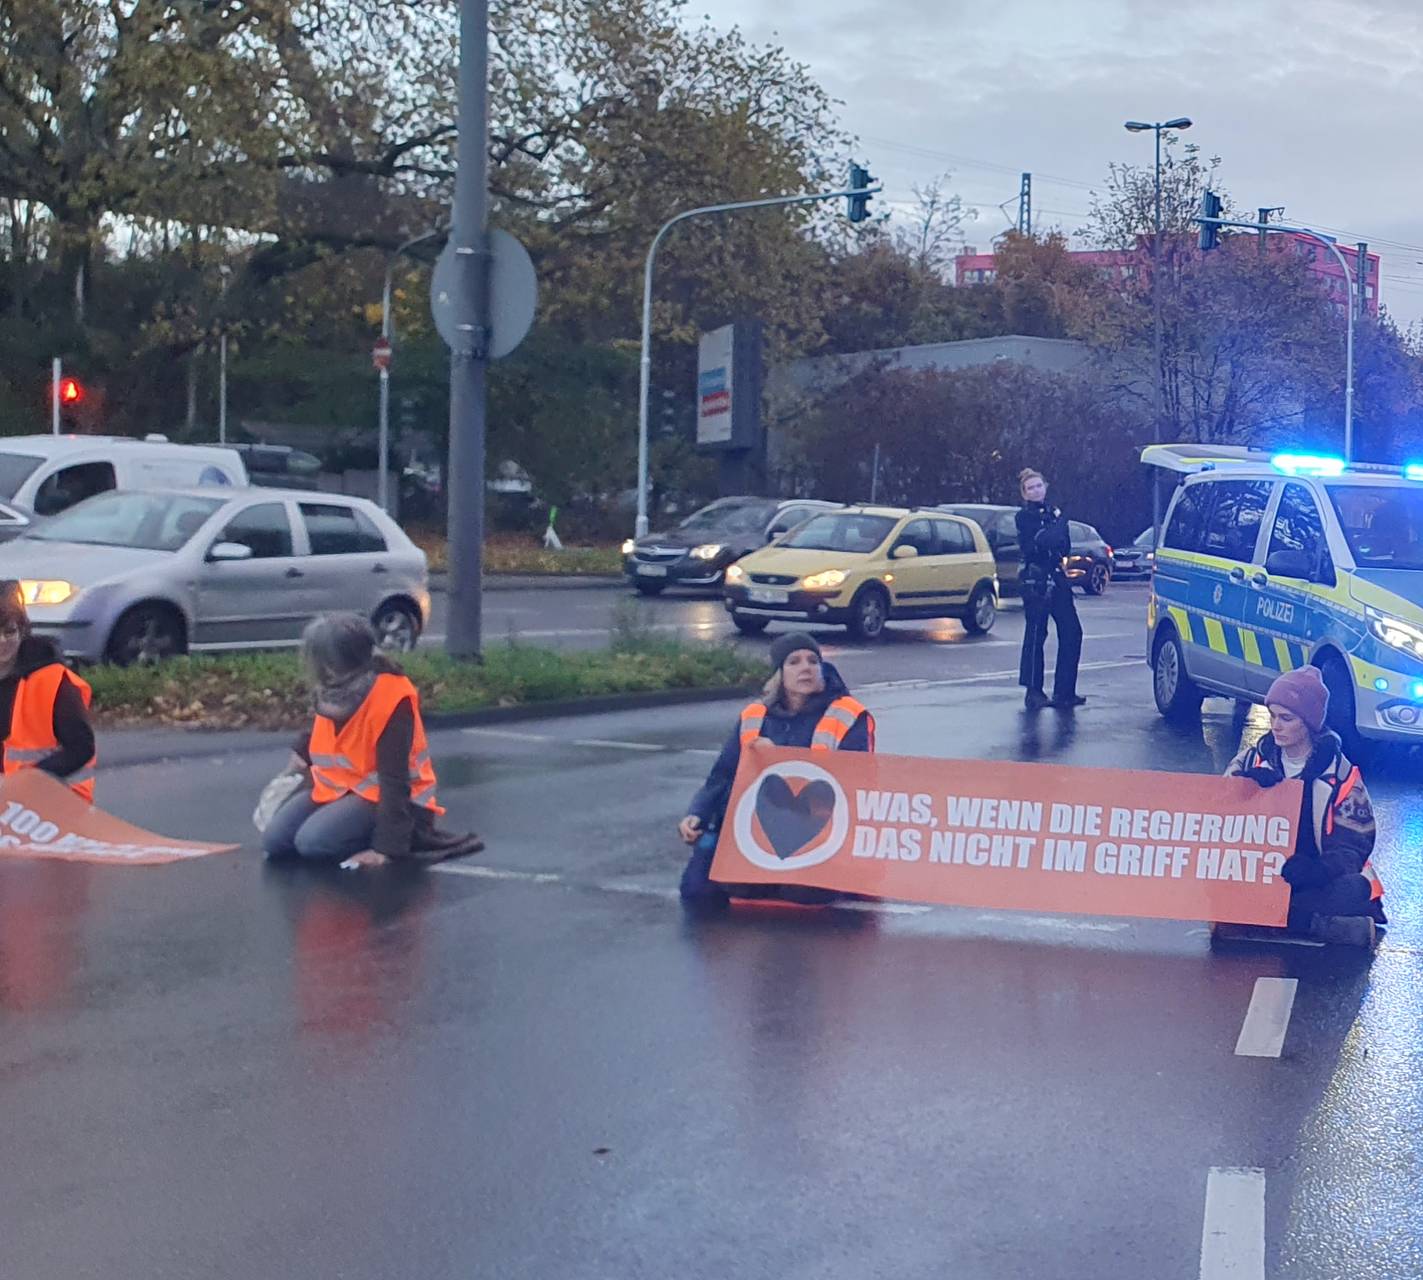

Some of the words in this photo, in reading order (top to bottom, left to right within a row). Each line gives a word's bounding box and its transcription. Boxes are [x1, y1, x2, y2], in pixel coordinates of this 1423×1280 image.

[1256, 596, 1295, 625] POLIZEI
[0, 801, 59, 843] 100
[855, 789, 938, 828] WAS,
[946, 796, 1043, 832] WENN
[1049, 803, 1103, 836] DIE
[1109, 807, 1291, 848] REGIERUNG
[852, 825, 923, 861] DAS
[928, 831, 1037, 868] NICHT
[1041, 838, 1088, 873] IM
[1094, 842, 1191, 878] GRIFF
[1196, 848, 1287, 884] HAT?
